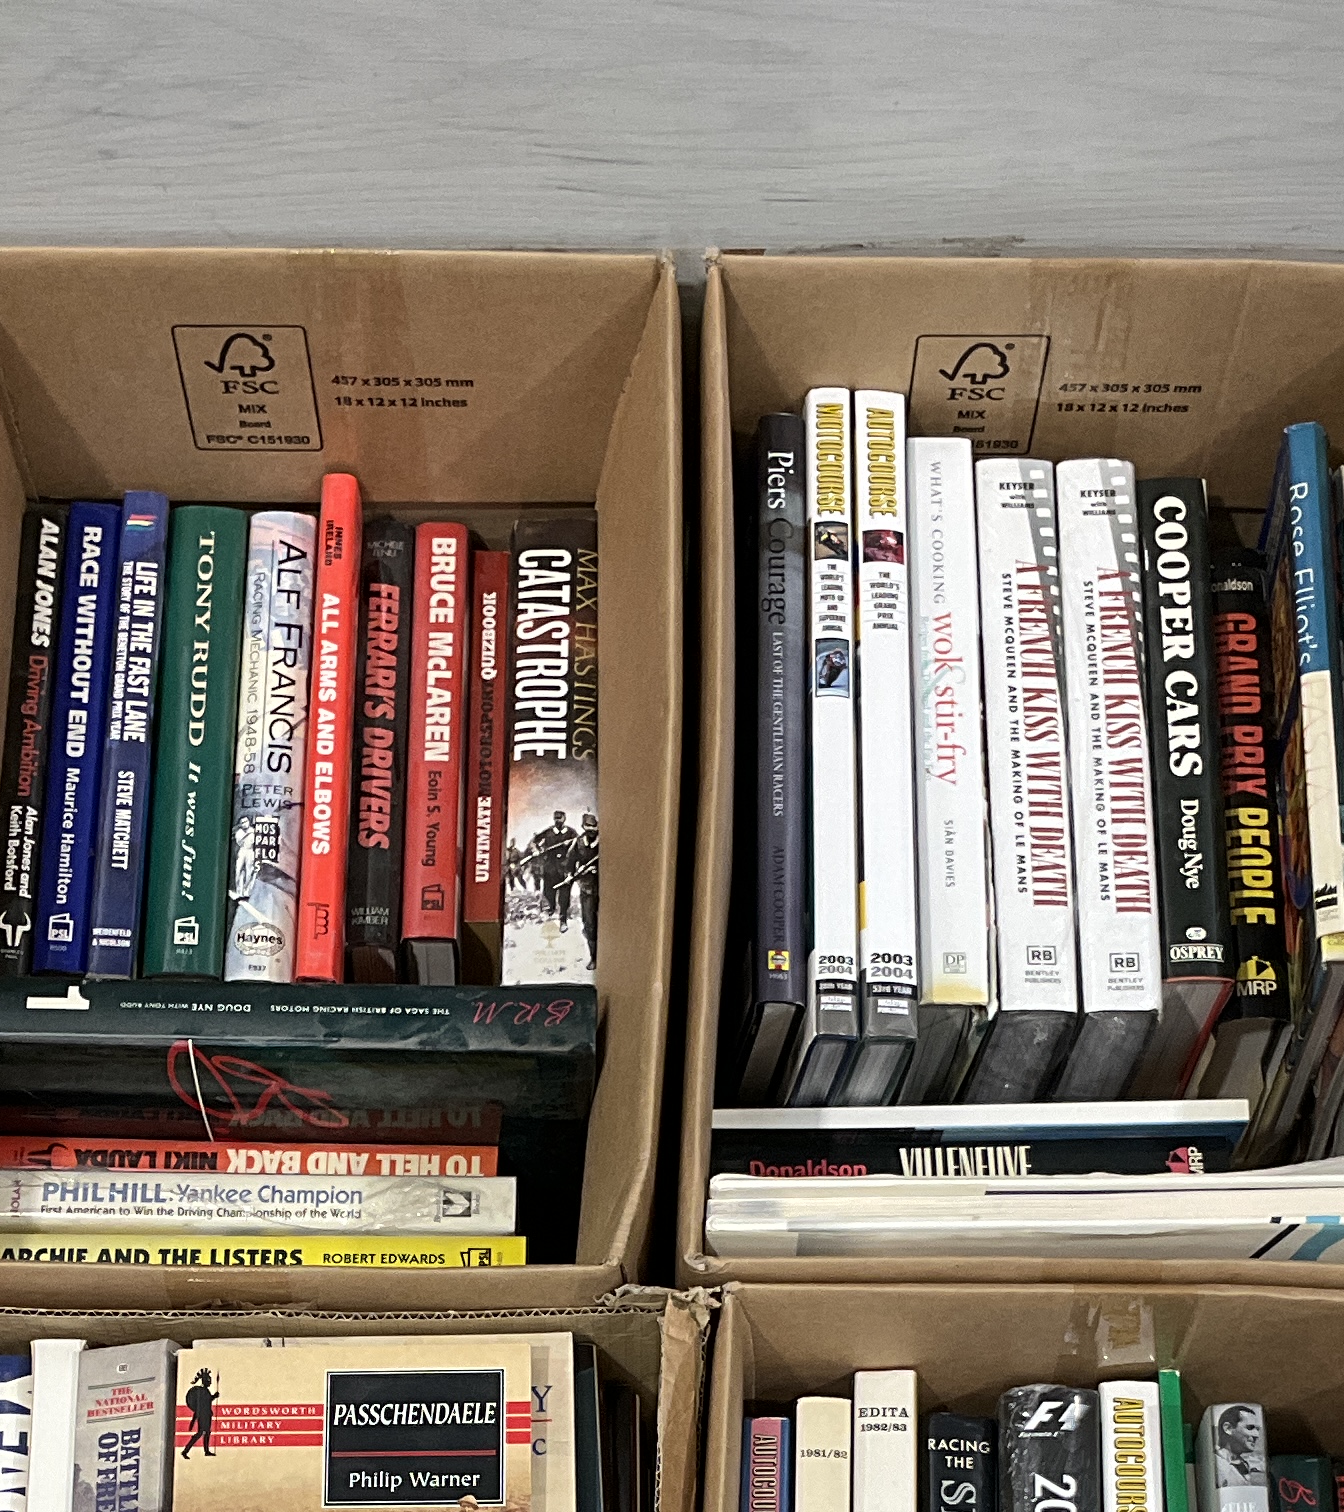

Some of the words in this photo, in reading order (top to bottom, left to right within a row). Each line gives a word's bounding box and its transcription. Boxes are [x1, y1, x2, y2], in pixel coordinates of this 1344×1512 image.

[221, 380, 279, 395] FSC
[239, 403, 267, 415] MIX
[239, 421, 272, 429] Board
[247, 434, 310, 445] C151930
[767, 450, 794, 509] Piers
[866, 408, 897, 518] AUTOCOURSE
[999, 482, 1034, 490] KEYSER
[930, 462, 943, 522] WHAT'S
[80, 525, 102, 587] RACE
[195, 532, 215, 628] TONY
[278, 540, 307, 608] ALF
[761, 517, 794, 625] Courage
[931, 529, 944, 604] COOKING
[1154, 496, 1195, 662] COOPER
[430, 537, 456, 624] BRUCE
[323, 593, 339, 628] ALL
[70, 594, 97, 703] WITHOUT
[318, 634, 337, 701] ARMS
[366, 583, 399, 722] FERRARI'S
[514, 549, 572, 760] CATASTROPHE
[188, 639, 210, 747] RUDD
[267, 622, 302, 773] FRANCIS
[424, 635, 454, 762] McLAREN
[66, 709, 88, 757] END
[316, 707, 334, 755] AND
[1164, 670, 1203, 777] CARS
[59, 767, 80, 822] Maurice
[312, 762, 333, 855] ELBOWS
[357, 727, 393, 849] DRIVERS
[1180, 799, 1199, 850] Doug
[56, 826, 75, 904] Hamilton
[1185, 854, 1204, 889] Nye
[237, 933, 283, 946] Haynes
[870, 953, 913, 966] 2003
[1170, 946, 1224, 960] OSPREY
[871, 967, 913, 979] 2004
[323, 1252, 373, 1264] ROBERT
[377, 1252, 444, 1264] EDWARDS
[220, 1421, 281, 1429] MILITARY
[221, 1406, 316, 1415] WORDSWORTH
[334, 1403, 496, 1426] PASSCHENDAELE
[859, 1407, 908, 1418] EDITA
[860, 1423, 906, 1432] 1982/83
[219, 1435, 274, 1444] LIBRARY
[800, 1448, 847, 1458] 1981/82
[928, 1438, 989, 1453] RACING
[946, 1455, 974, 1469] THE
[349, 1470, 400, 1492] Philip
[408, 1470, 480, 1488] Warner
